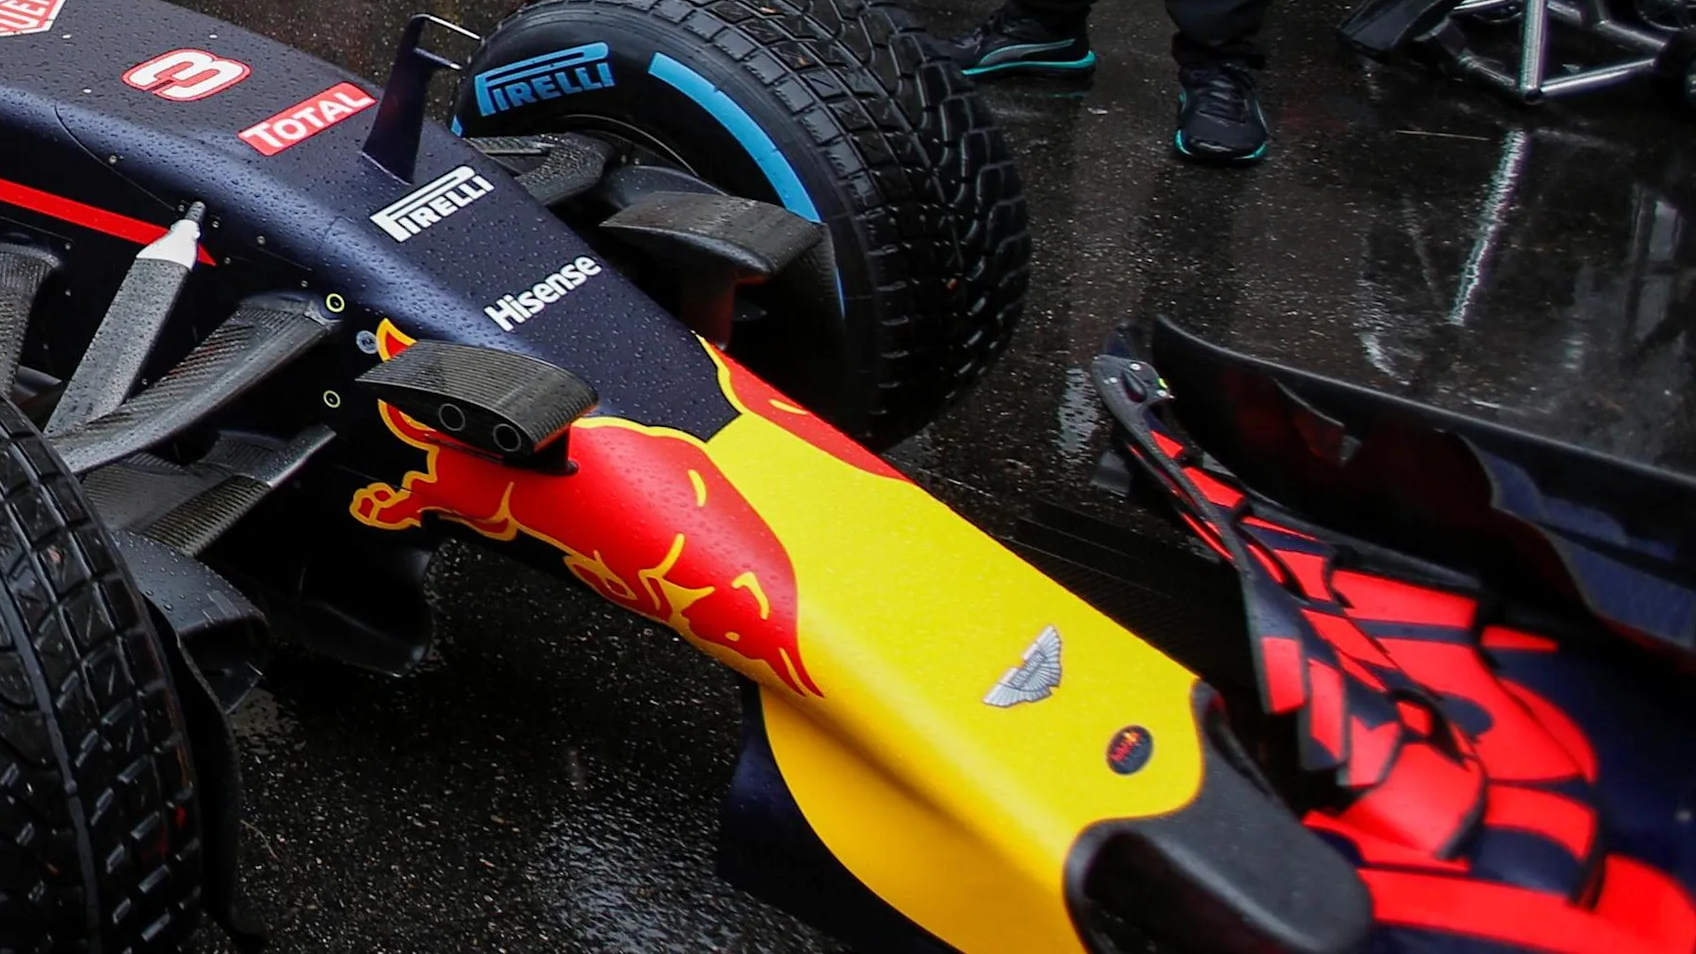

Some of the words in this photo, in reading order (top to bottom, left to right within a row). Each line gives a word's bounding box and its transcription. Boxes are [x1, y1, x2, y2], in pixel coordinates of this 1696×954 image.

[121, 48, 251, 102] 3
[474, 41, 615, 117] PIRELLI
[242, 89, 373, 149] TOTAL
[369, 165, 495, 243] PIRELLI
[484, 253, 603, 332] Hisense
